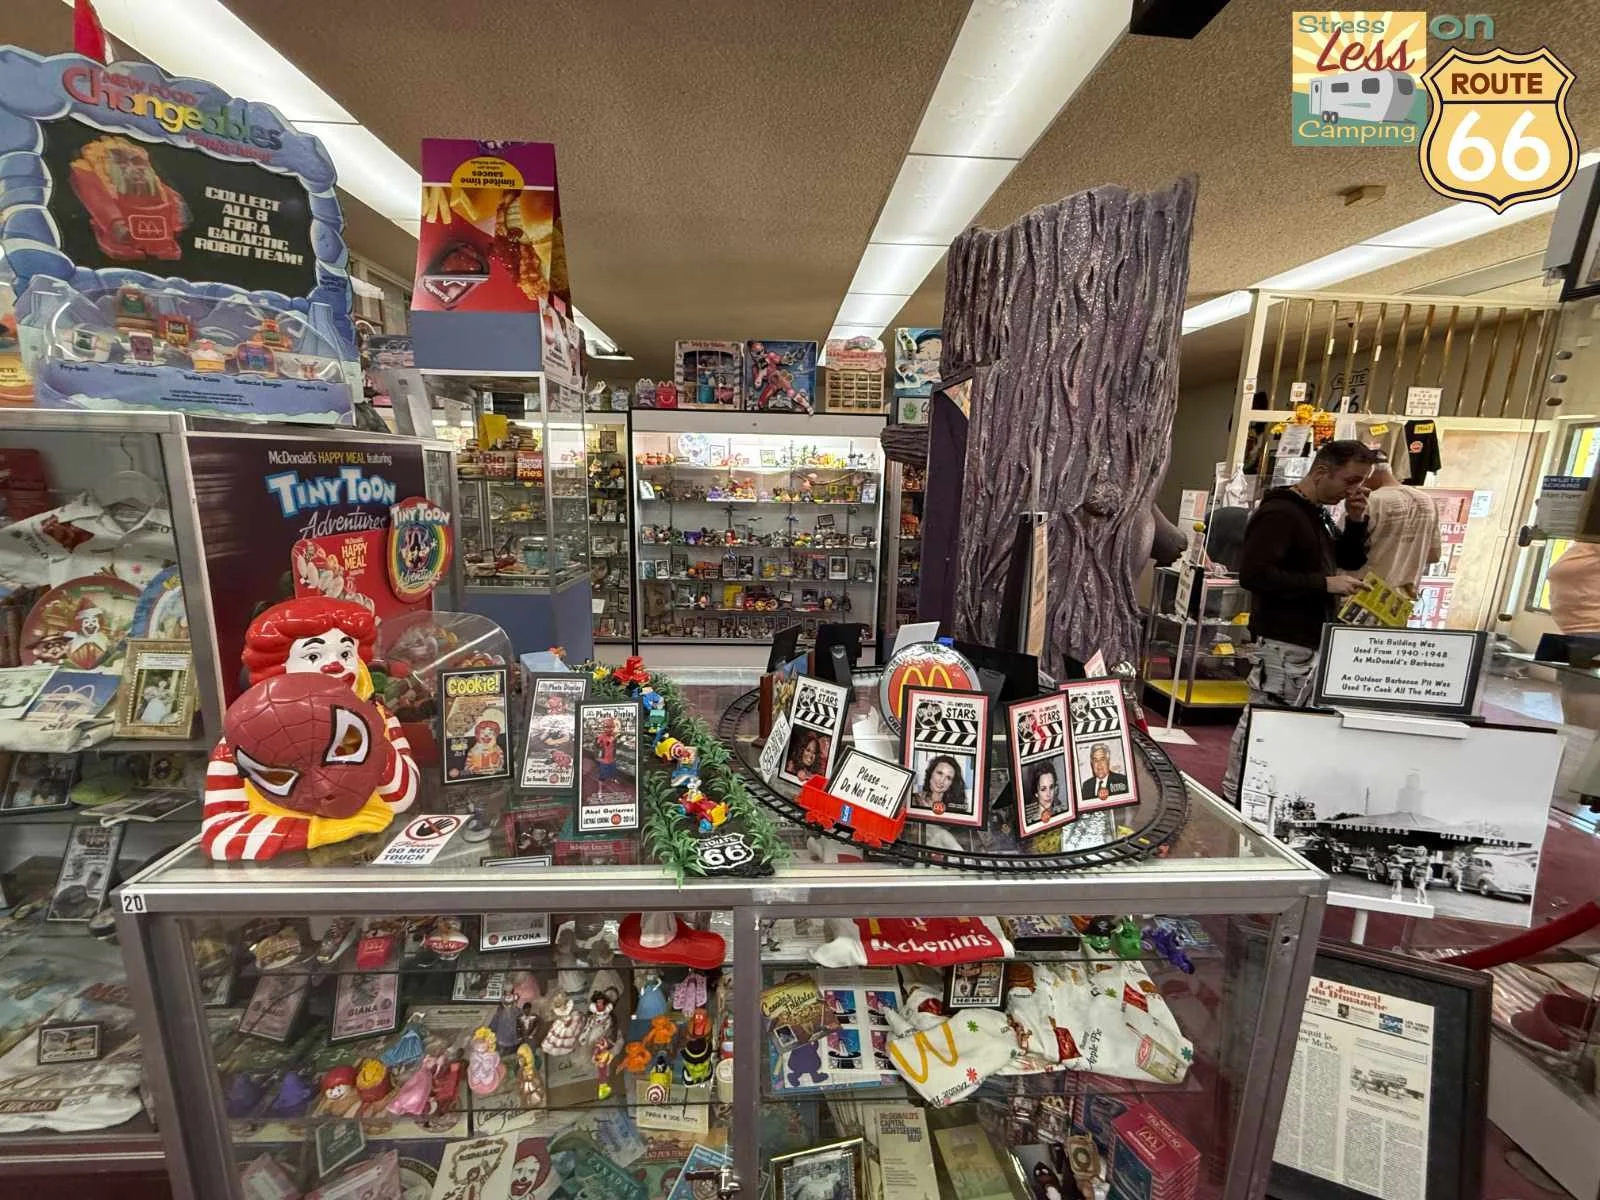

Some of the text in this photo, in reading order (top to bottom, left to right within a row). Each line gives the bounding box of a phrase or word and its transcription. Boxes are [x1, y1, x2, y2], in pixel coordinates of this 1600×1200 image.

[62, 66, 284, 151] Changeables
[471, 170, 505, 178] sauces
[460, 177, 516, 187] limited time
[205, 186, 281, 212] COLLECT
[222, 203, 269, 222] ALL 8
[223, 216, 272, 237] FOR A
[207, 226, 290, 252] GALACTIC
[194, 237, 305, 266] ROBOT TEAM!
[268, 450, 393, 467] McDonald's HAPPY MEAL featuring
[481, 452, 505, 465] Big
[517, 467, 543, 478] Fries
[265, 466, 397, 516] TINY TOON
[389, 502, 451, 529] TINY TOON
[299, 506, 388, 541] Adventures
[341, 543, 367, 556] HAPPY
[342, 555, 367, 570] MEAL
[1353, 646, 1372, 654] Used
[1373, 647, 1392, 655] From
[1386, 638, 1416, 648] Building
[1420, 640, 1436, 648] Was
[1353, 655, 1445, 668] As McDonald's Barbecue
[1354, 674, 1383, 683] Outdoor
[1385, 676, 1419, 685] Barbecue
[1421, 678, 1432, 686] Pit
[1435, 680, 1451, 688] Was
[1341, 683, 1359, 691] Used
[1373, 685, 1392, 693] Cook
[1408, 687, 1422, 695] The
[817, 693, 839, 707] STARS
[1091, 695, 1115, 706] STARS
[945, 707, 976, 720] STARS
[1039, 710, 1061, 725] STARS
[856, 766, 881, 786] Please
[840, 777, 851, 792] Do
[851, 782, 866, 799] Not
[703, 845, 747, 866] 66
[124, 896, 144, 912] 20
[501, 932, 541, 943] ARIZONA
[1319, 981, 1383, 1003] Le Journal
[1328, 990, 1389, 1011] Dimanche
